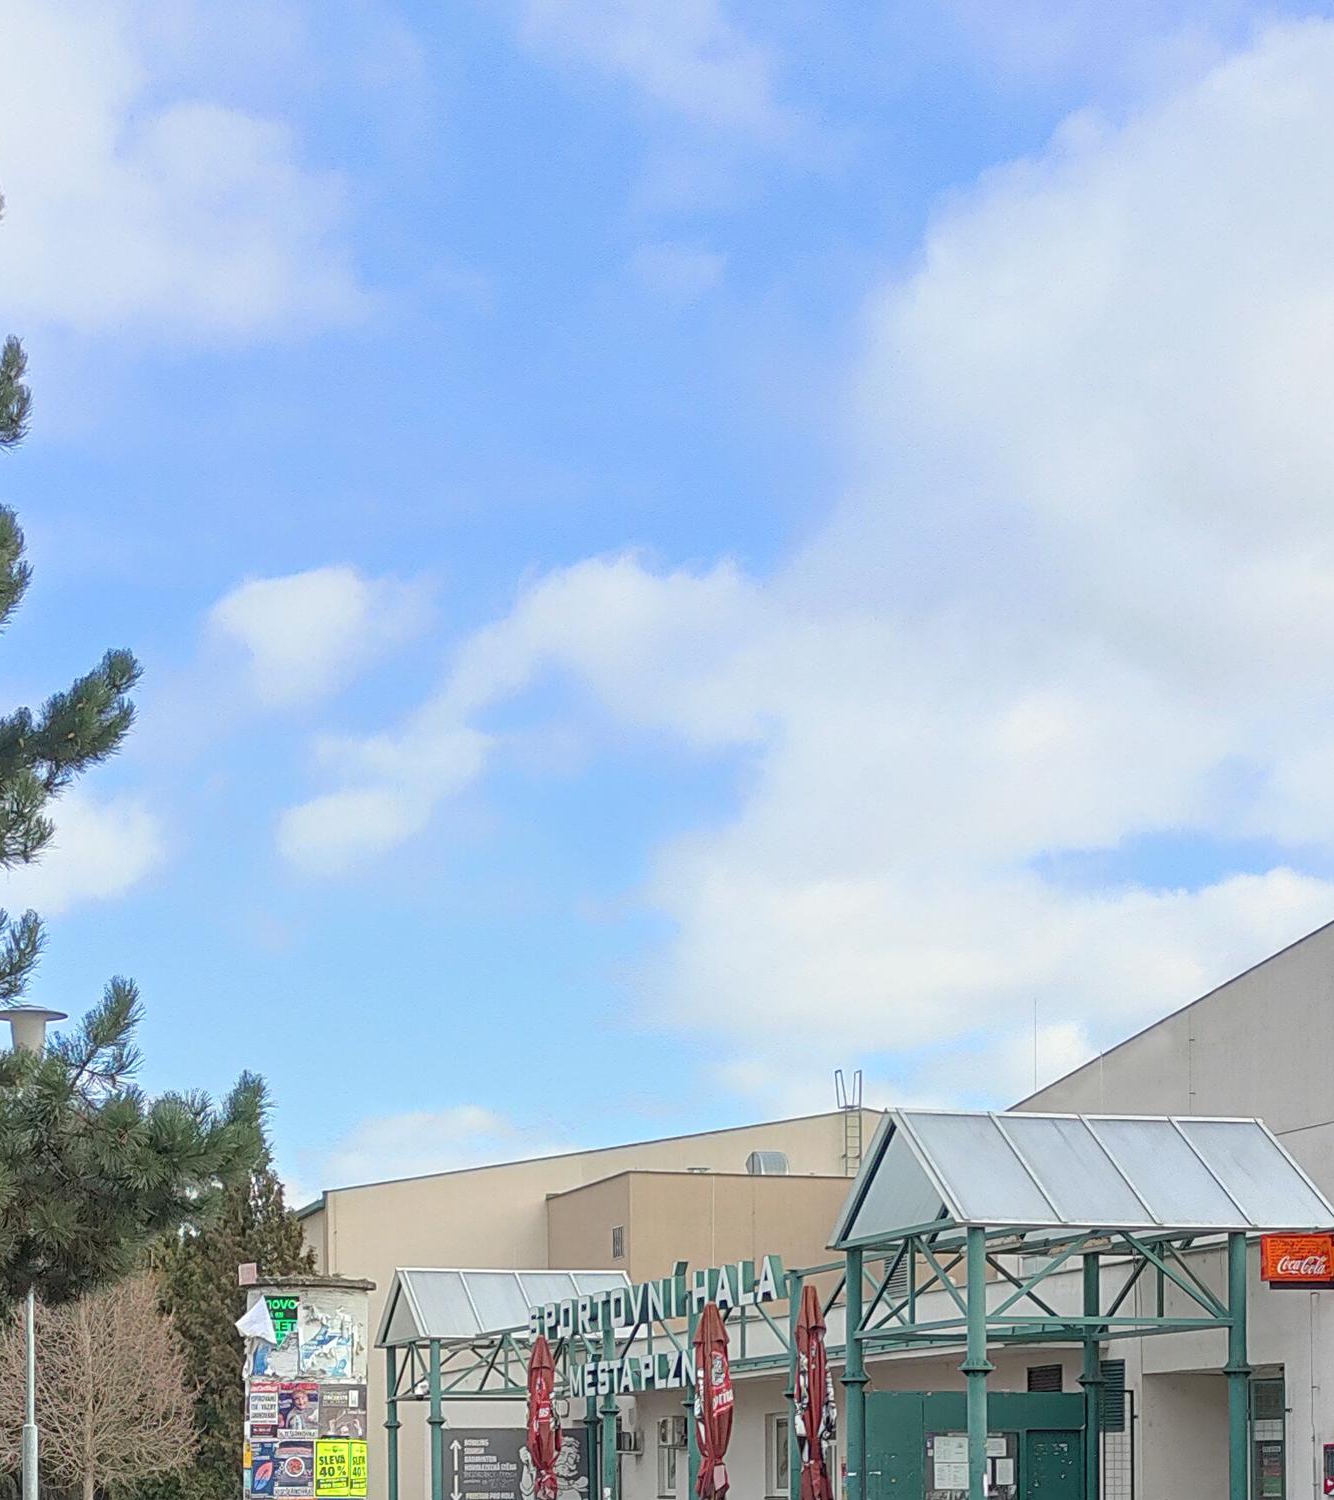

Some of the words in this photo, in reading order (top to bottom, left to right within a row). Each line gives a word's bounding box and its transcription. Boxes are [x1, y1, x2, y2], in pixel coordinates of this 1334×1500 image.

[529, 1261, 688, 1343] SPORTOVNÍ
[693, 1255, 788, 1314] HALA
[569, 1354, 641, 1397] MĚSTA
[641, 1350, 696, 1391] PLZN
[319, 1455, 346, 1466] SLEVA
[319, 1467, 335, 1477] 40
